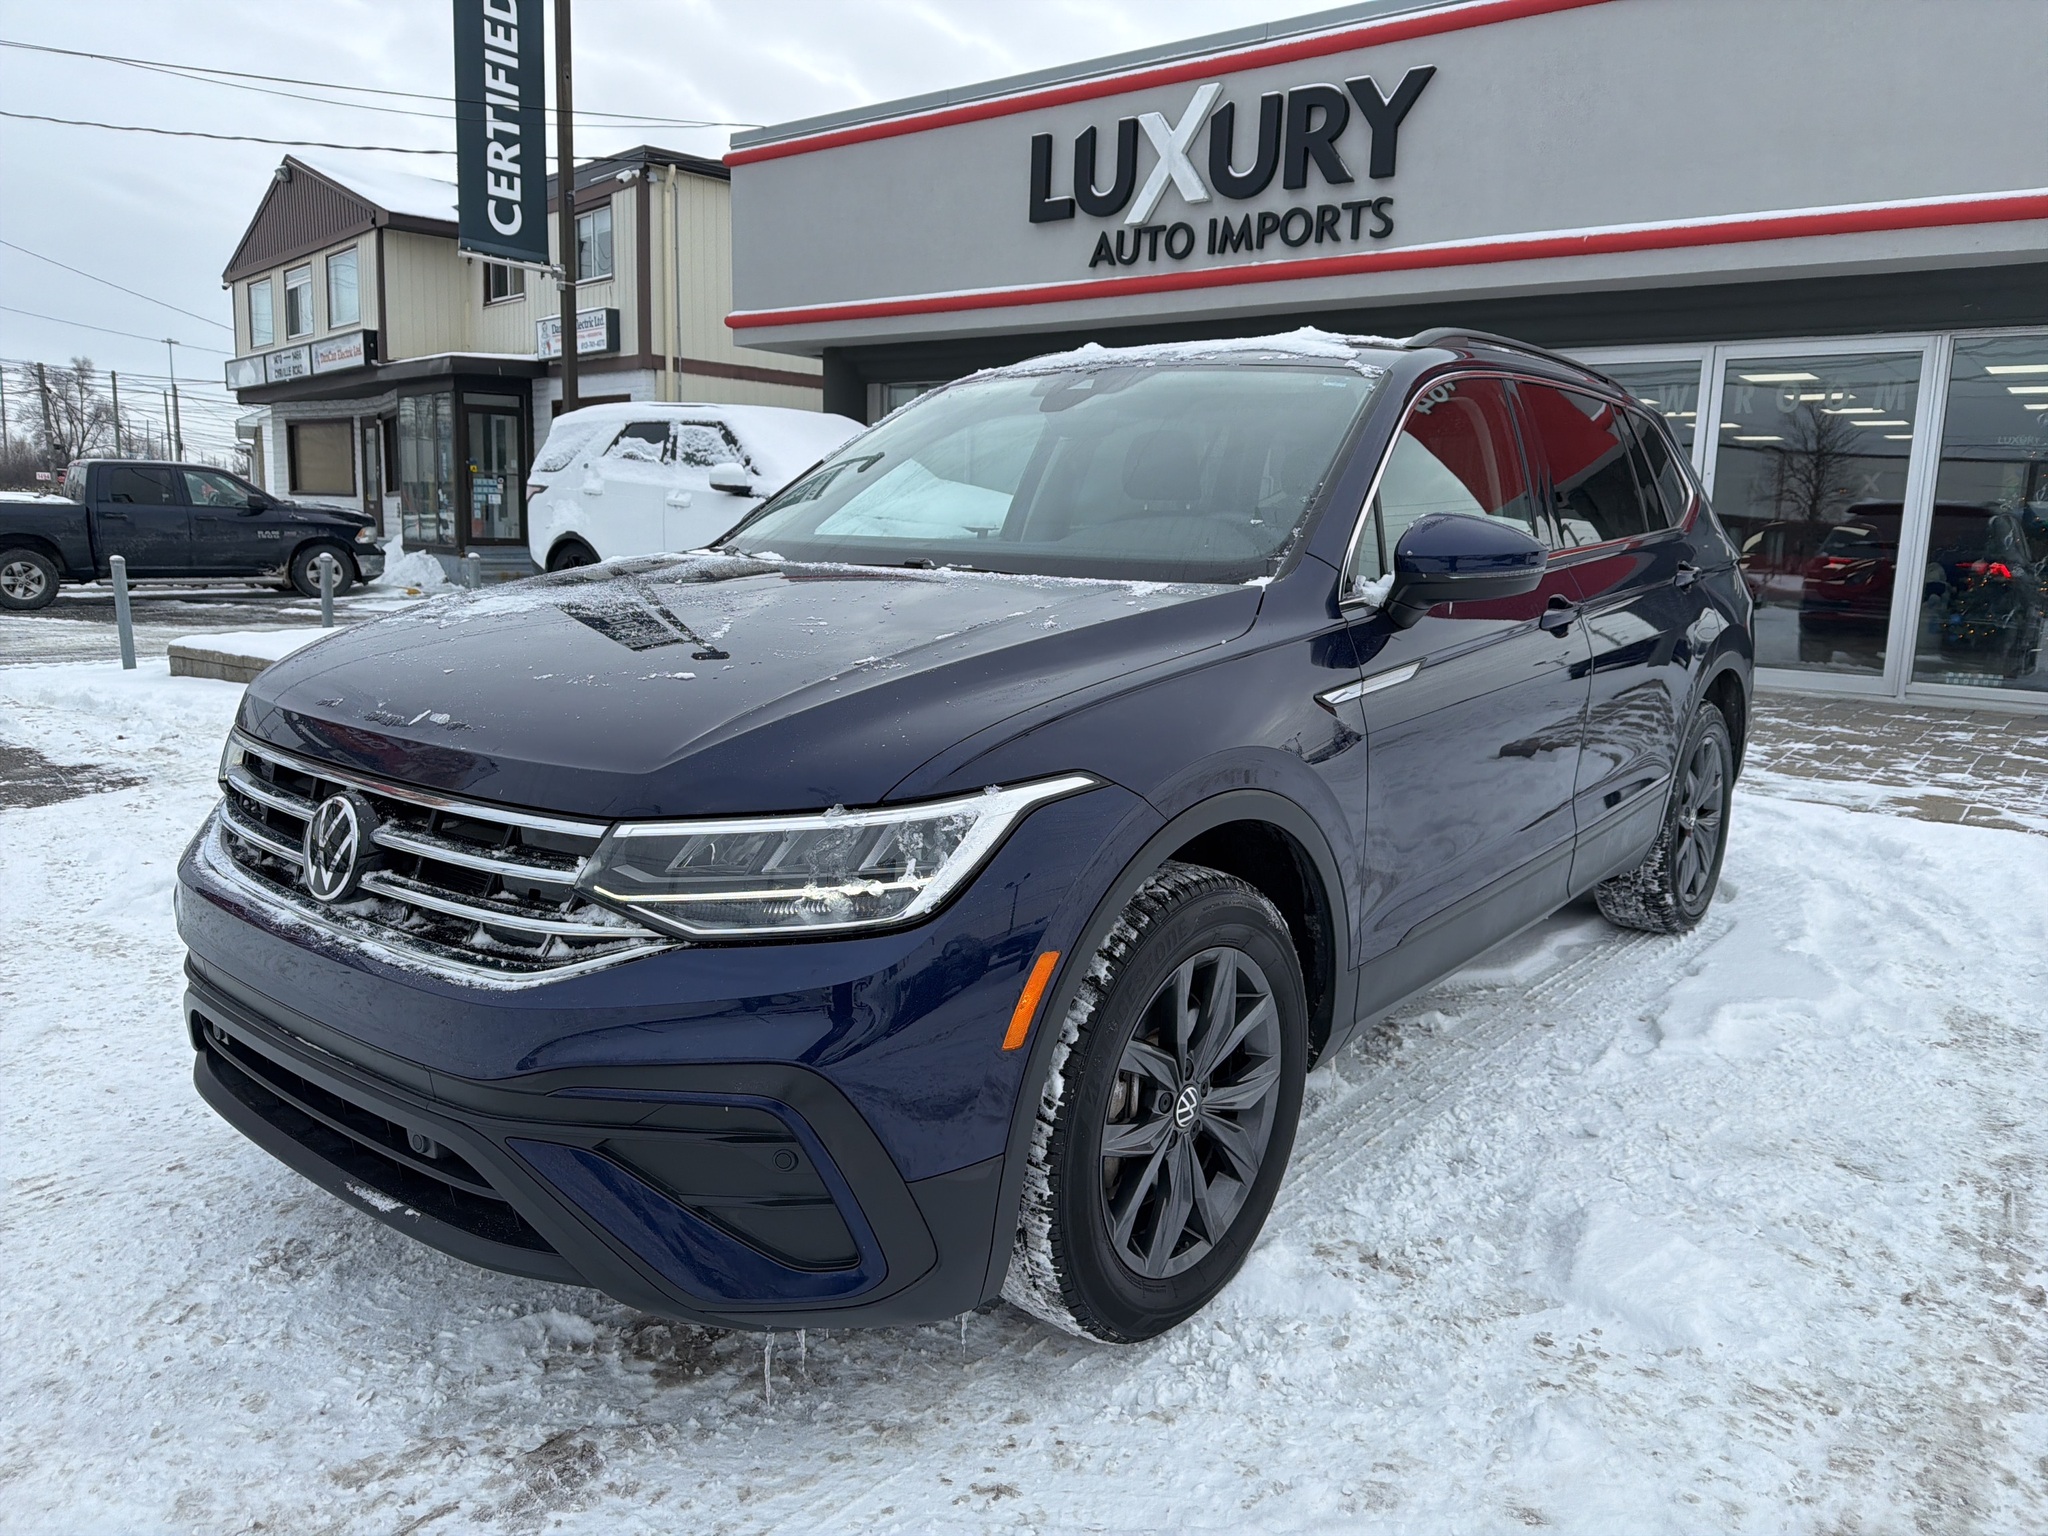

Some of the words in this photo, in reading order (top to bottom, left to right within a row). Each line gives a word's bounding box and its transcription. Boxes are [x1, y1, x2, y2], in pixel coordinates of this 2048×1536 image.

[483, 0, 523, 236] CERTIFIED
[1029, 64, 1437, 227] LUXURY
[1088, 221, 1195, 268] AUTO
[1207, 196, 1394, 255] IMPORTS
